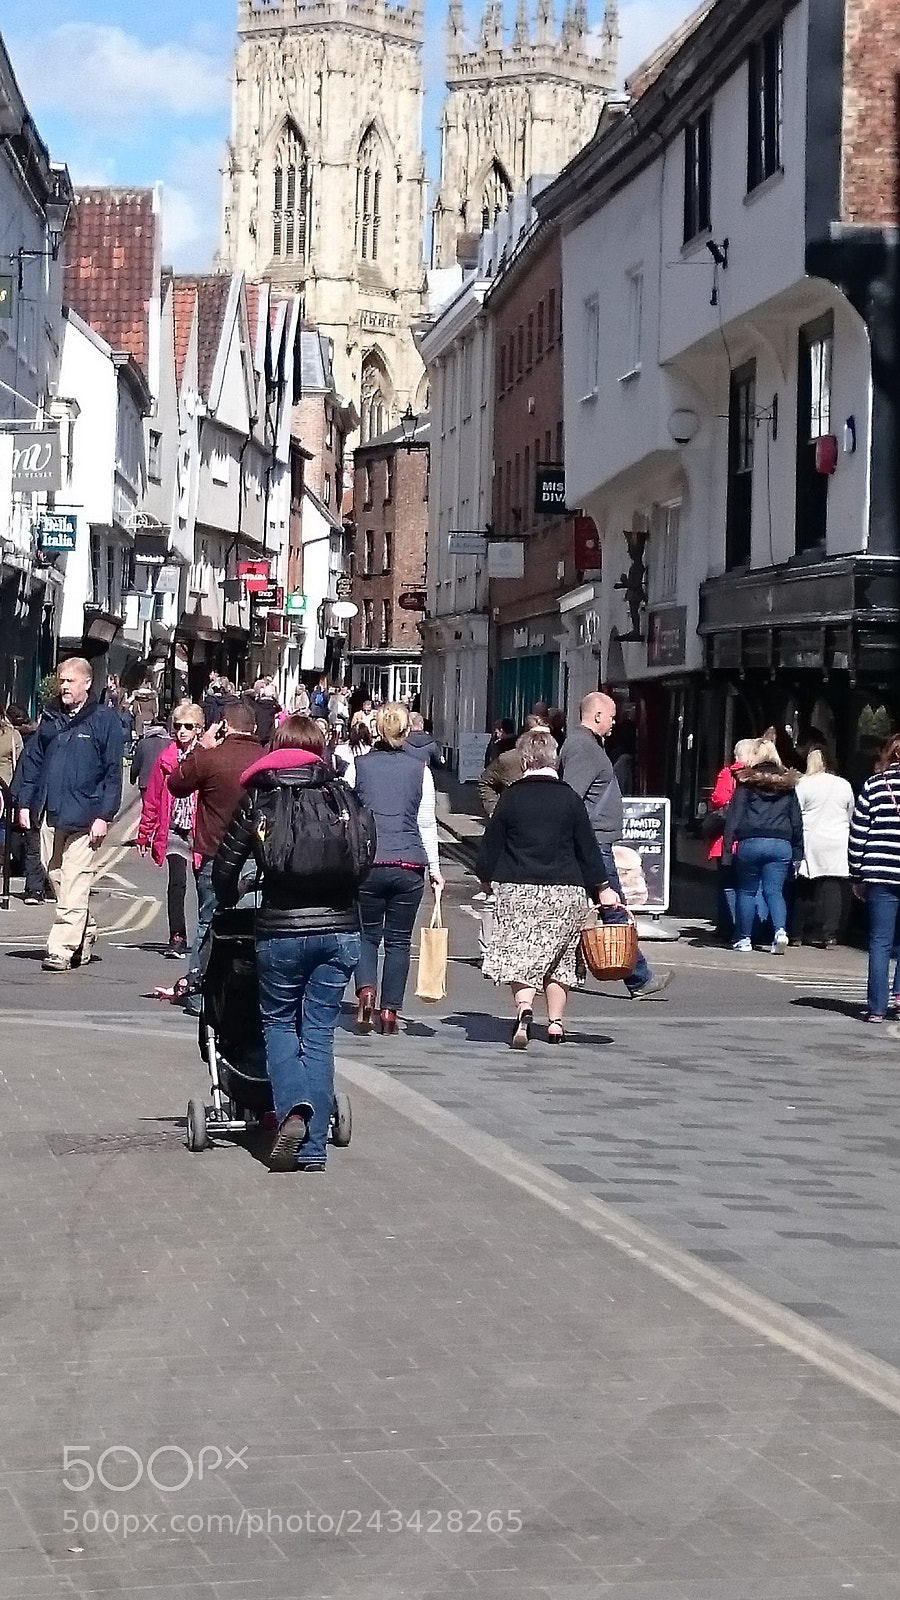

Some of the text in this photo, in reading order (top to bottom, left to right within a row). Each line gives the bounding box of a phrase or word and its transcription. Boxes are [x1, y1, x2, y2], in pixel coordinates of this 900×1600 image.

[542, 481, 564, 492] MIS
[43, 516, 74, 532] Bella
[41, 532, 75, 547] Italia
